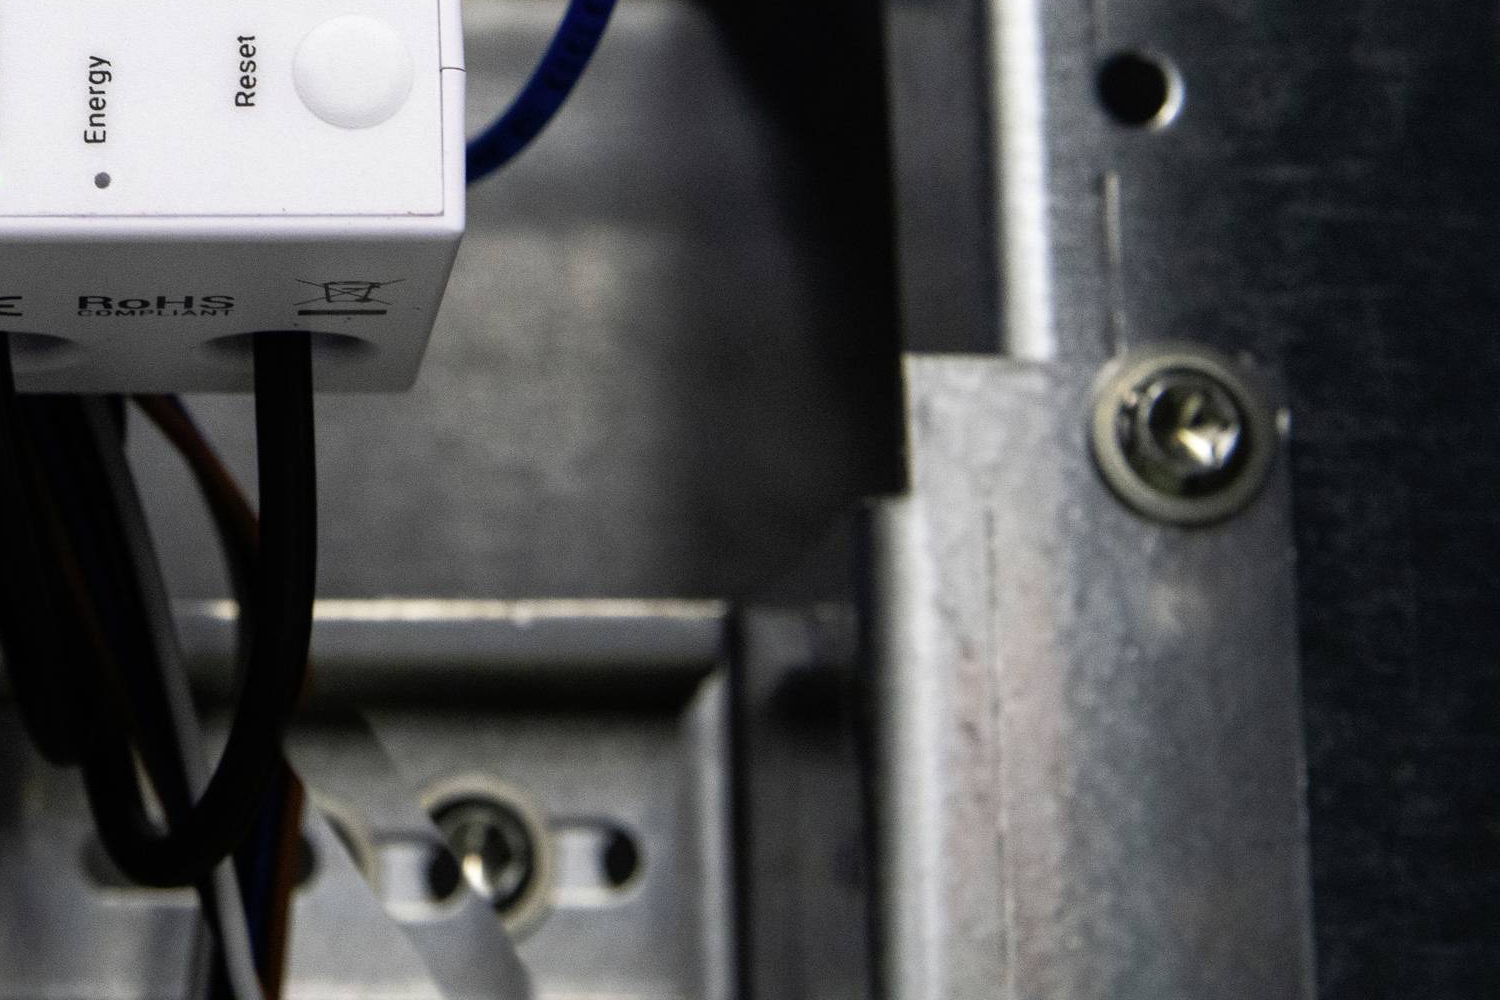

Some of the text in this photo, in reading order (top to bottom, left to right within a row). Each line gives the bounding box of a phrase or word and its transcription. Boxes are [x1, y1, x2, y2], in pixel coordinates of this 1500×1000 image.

[235, 35, 257, 107] Reset
[84, 55, 112, 143] Energy
[77, 295, 236, 310] RoHS
[77, 309, 235, 317] COMPLIANT
